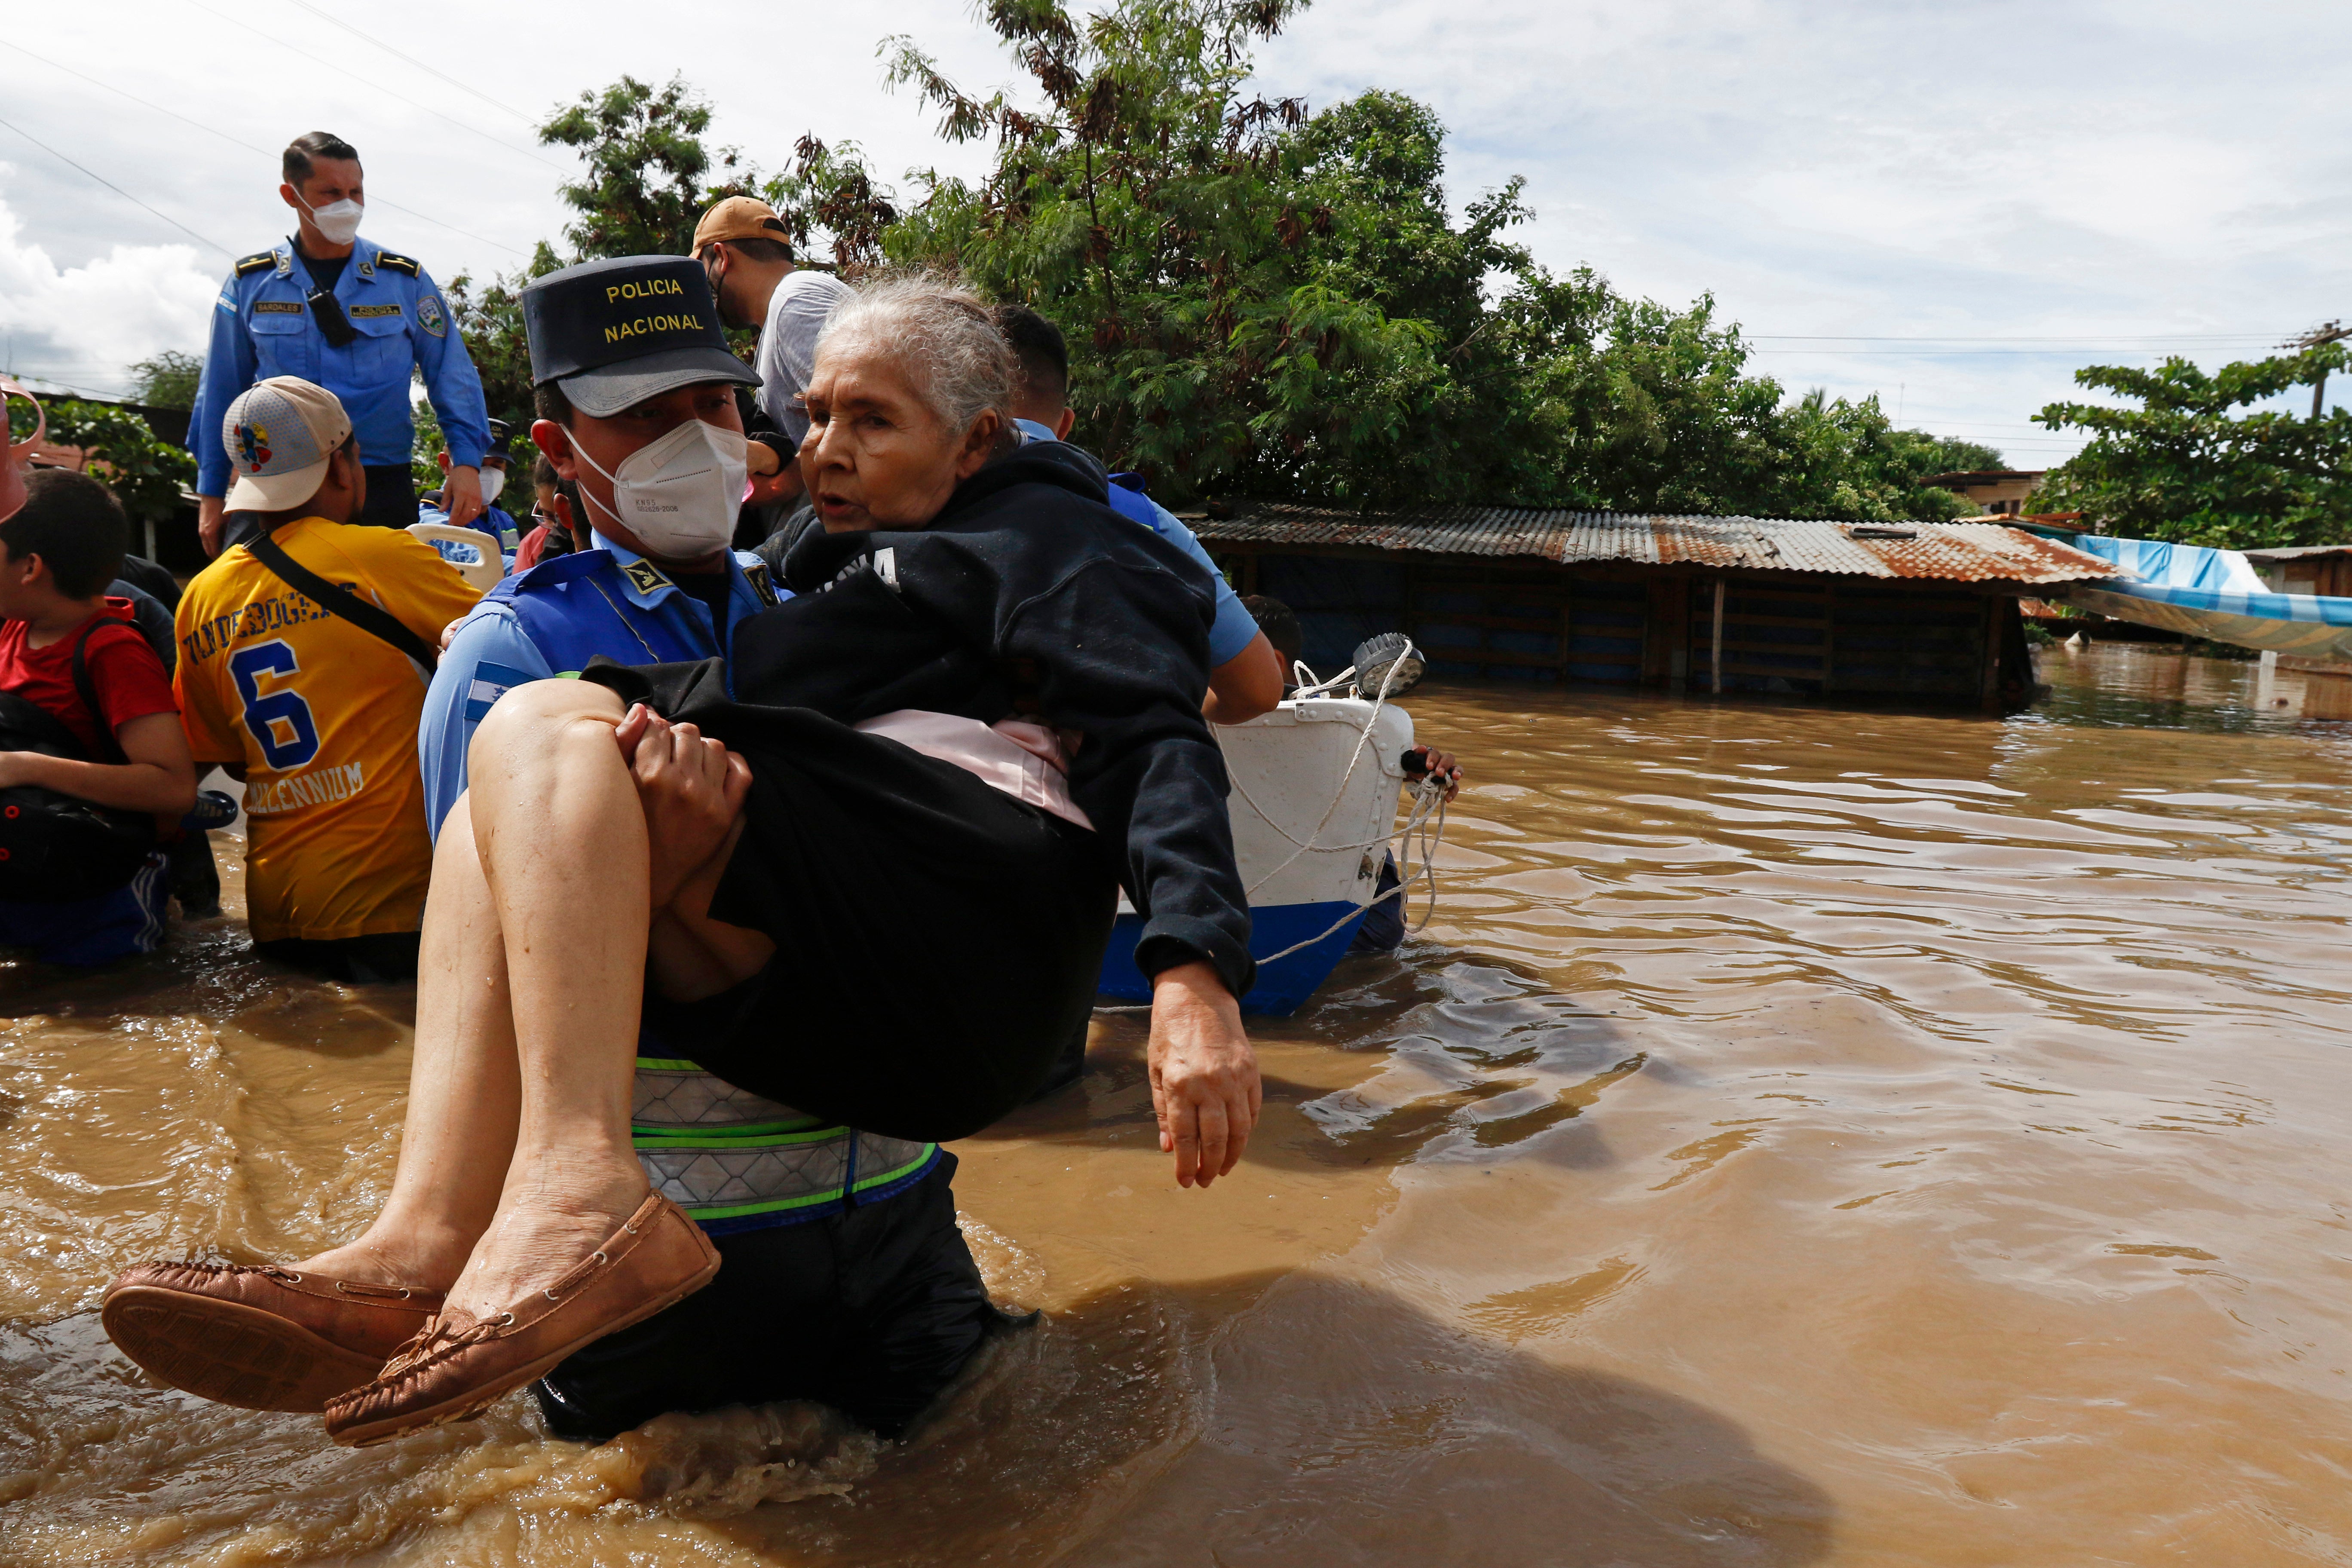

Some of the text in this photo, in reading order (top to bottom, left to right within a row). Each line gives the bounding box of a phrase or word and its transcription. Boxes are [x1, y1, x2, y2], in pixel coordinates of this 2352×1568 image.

[606, 279, 683, 303] POLICIA
[258, 303, 298, 312] BARDALES
[605, 314, 704, 343] NACIONAL
[226, 638, 320, 772] 6
